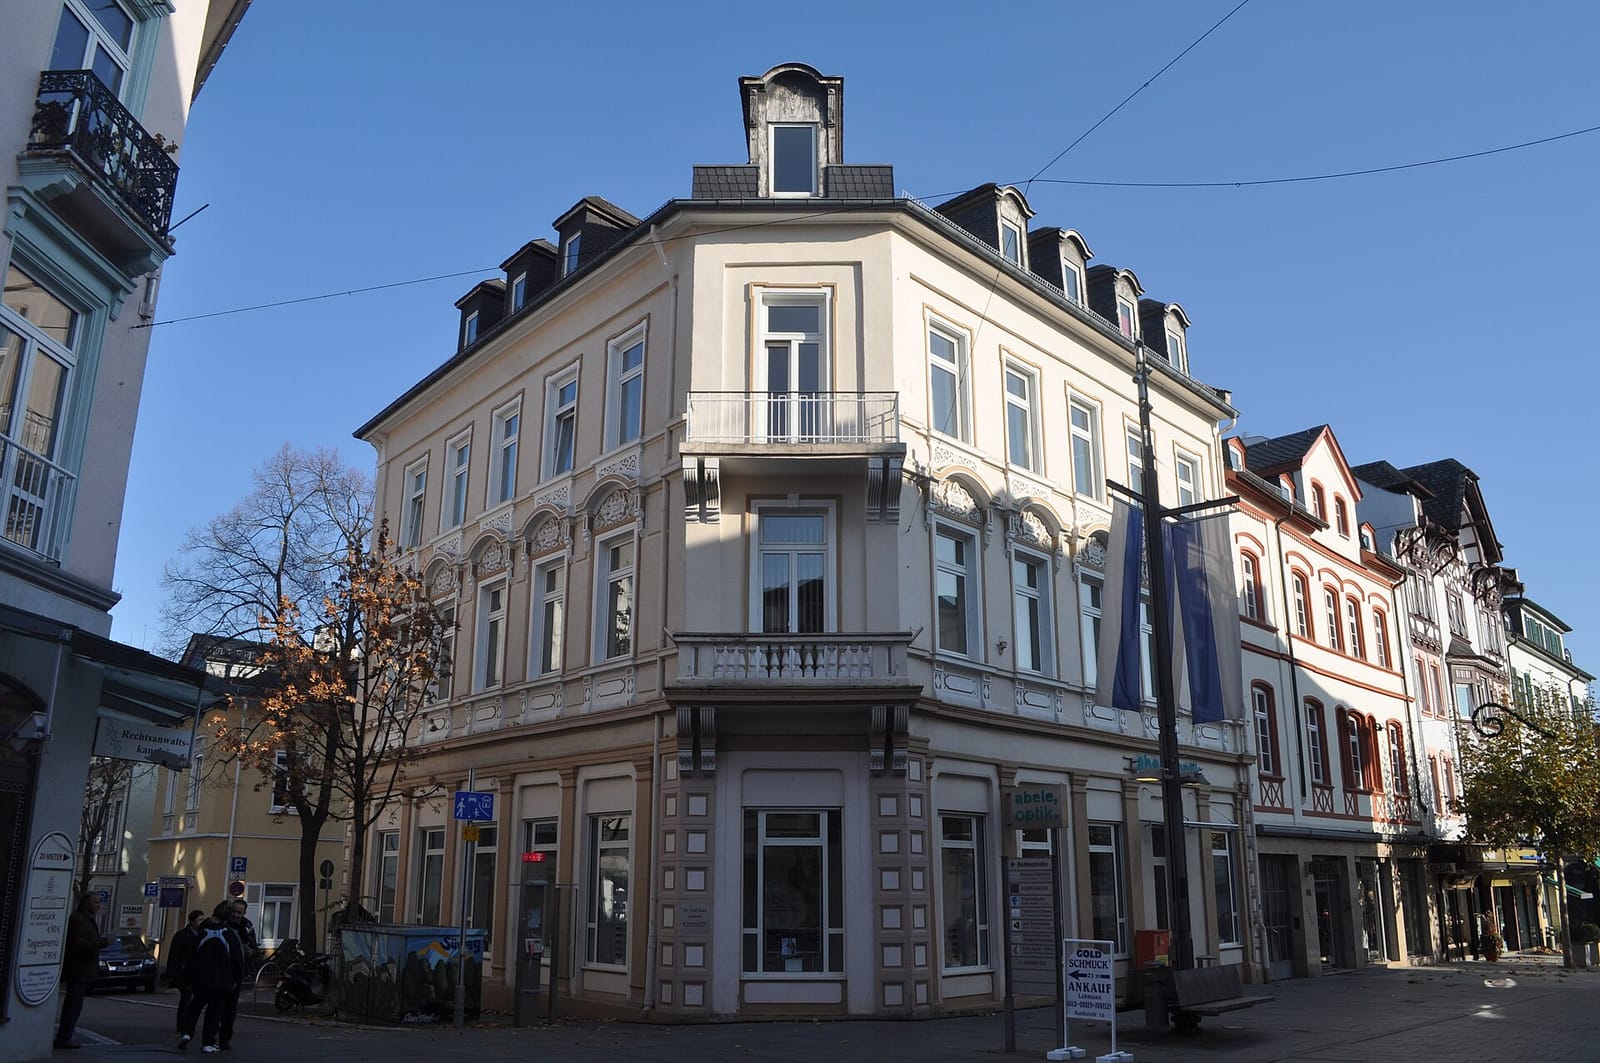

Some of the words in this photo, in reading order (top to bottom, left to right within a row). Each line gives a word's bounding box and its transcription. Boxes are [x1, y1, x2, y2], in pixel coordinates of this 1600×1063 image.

[121, 730, 189, 746] Rechtsanwalts-
[1015, 790, 1058, 805] abele,
[46, 853, 62, 861] METER
[30, 911, 56, 921] Frühstück
[1076, 949, 1102, 958] GOLD
[1069, 958, 1109, 969] SCHMUCK
[1067, 982, 1112, 994] ANKAUF
